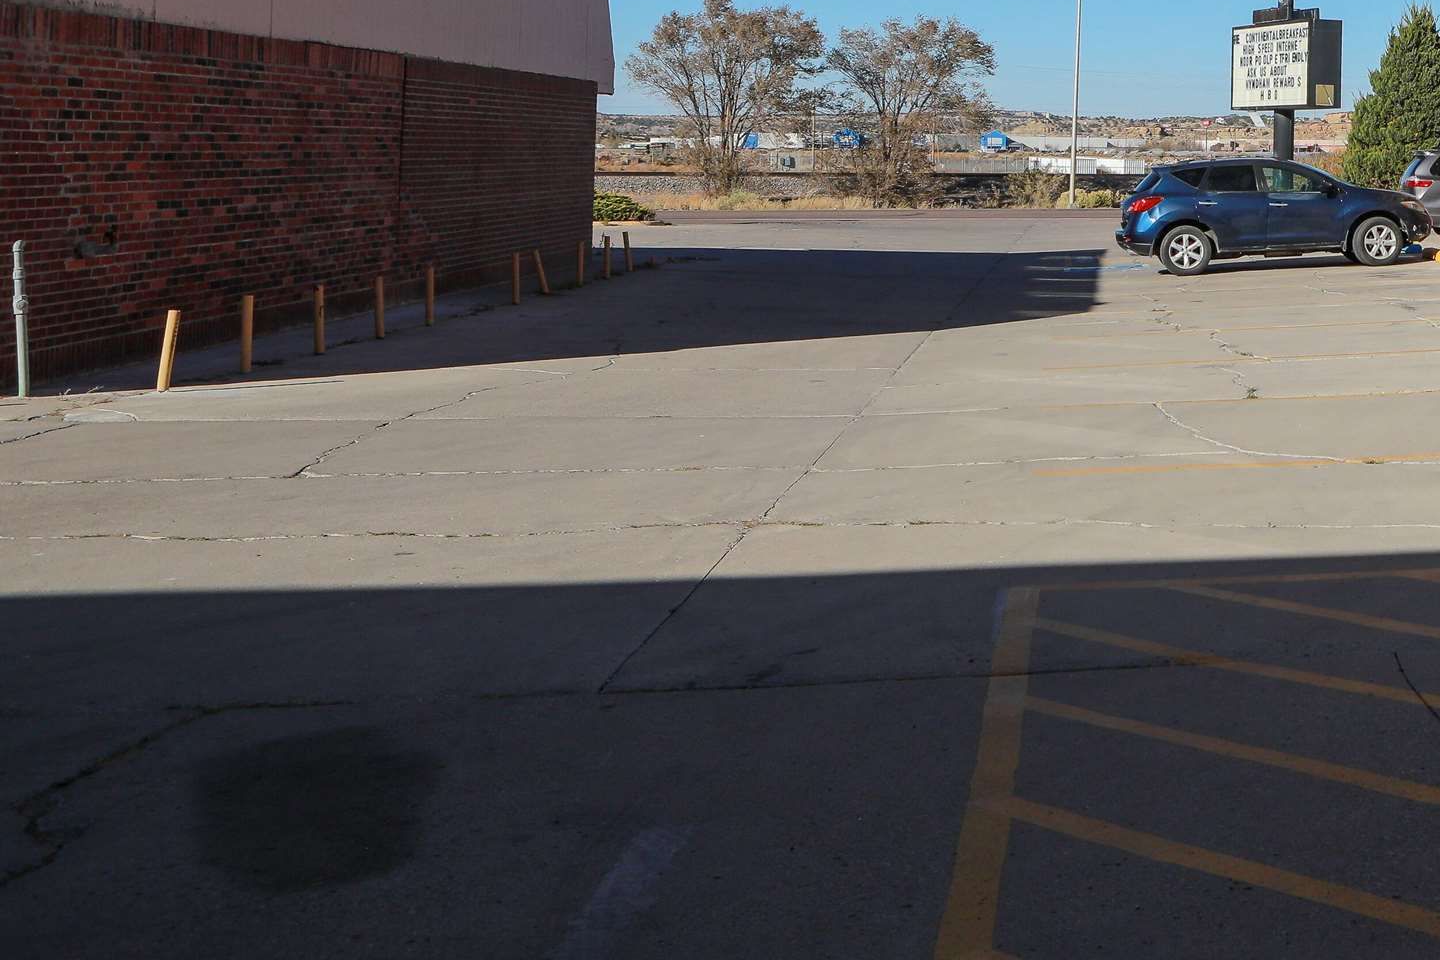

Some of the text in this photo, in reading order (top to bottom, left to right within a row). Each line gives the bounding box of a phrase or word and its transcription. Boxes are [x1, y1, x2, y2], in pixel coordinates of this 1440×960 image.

[1276, 40, 1302, 53] INTERNE
[1247, 64, 1288, 78] ASK US ABOUT
